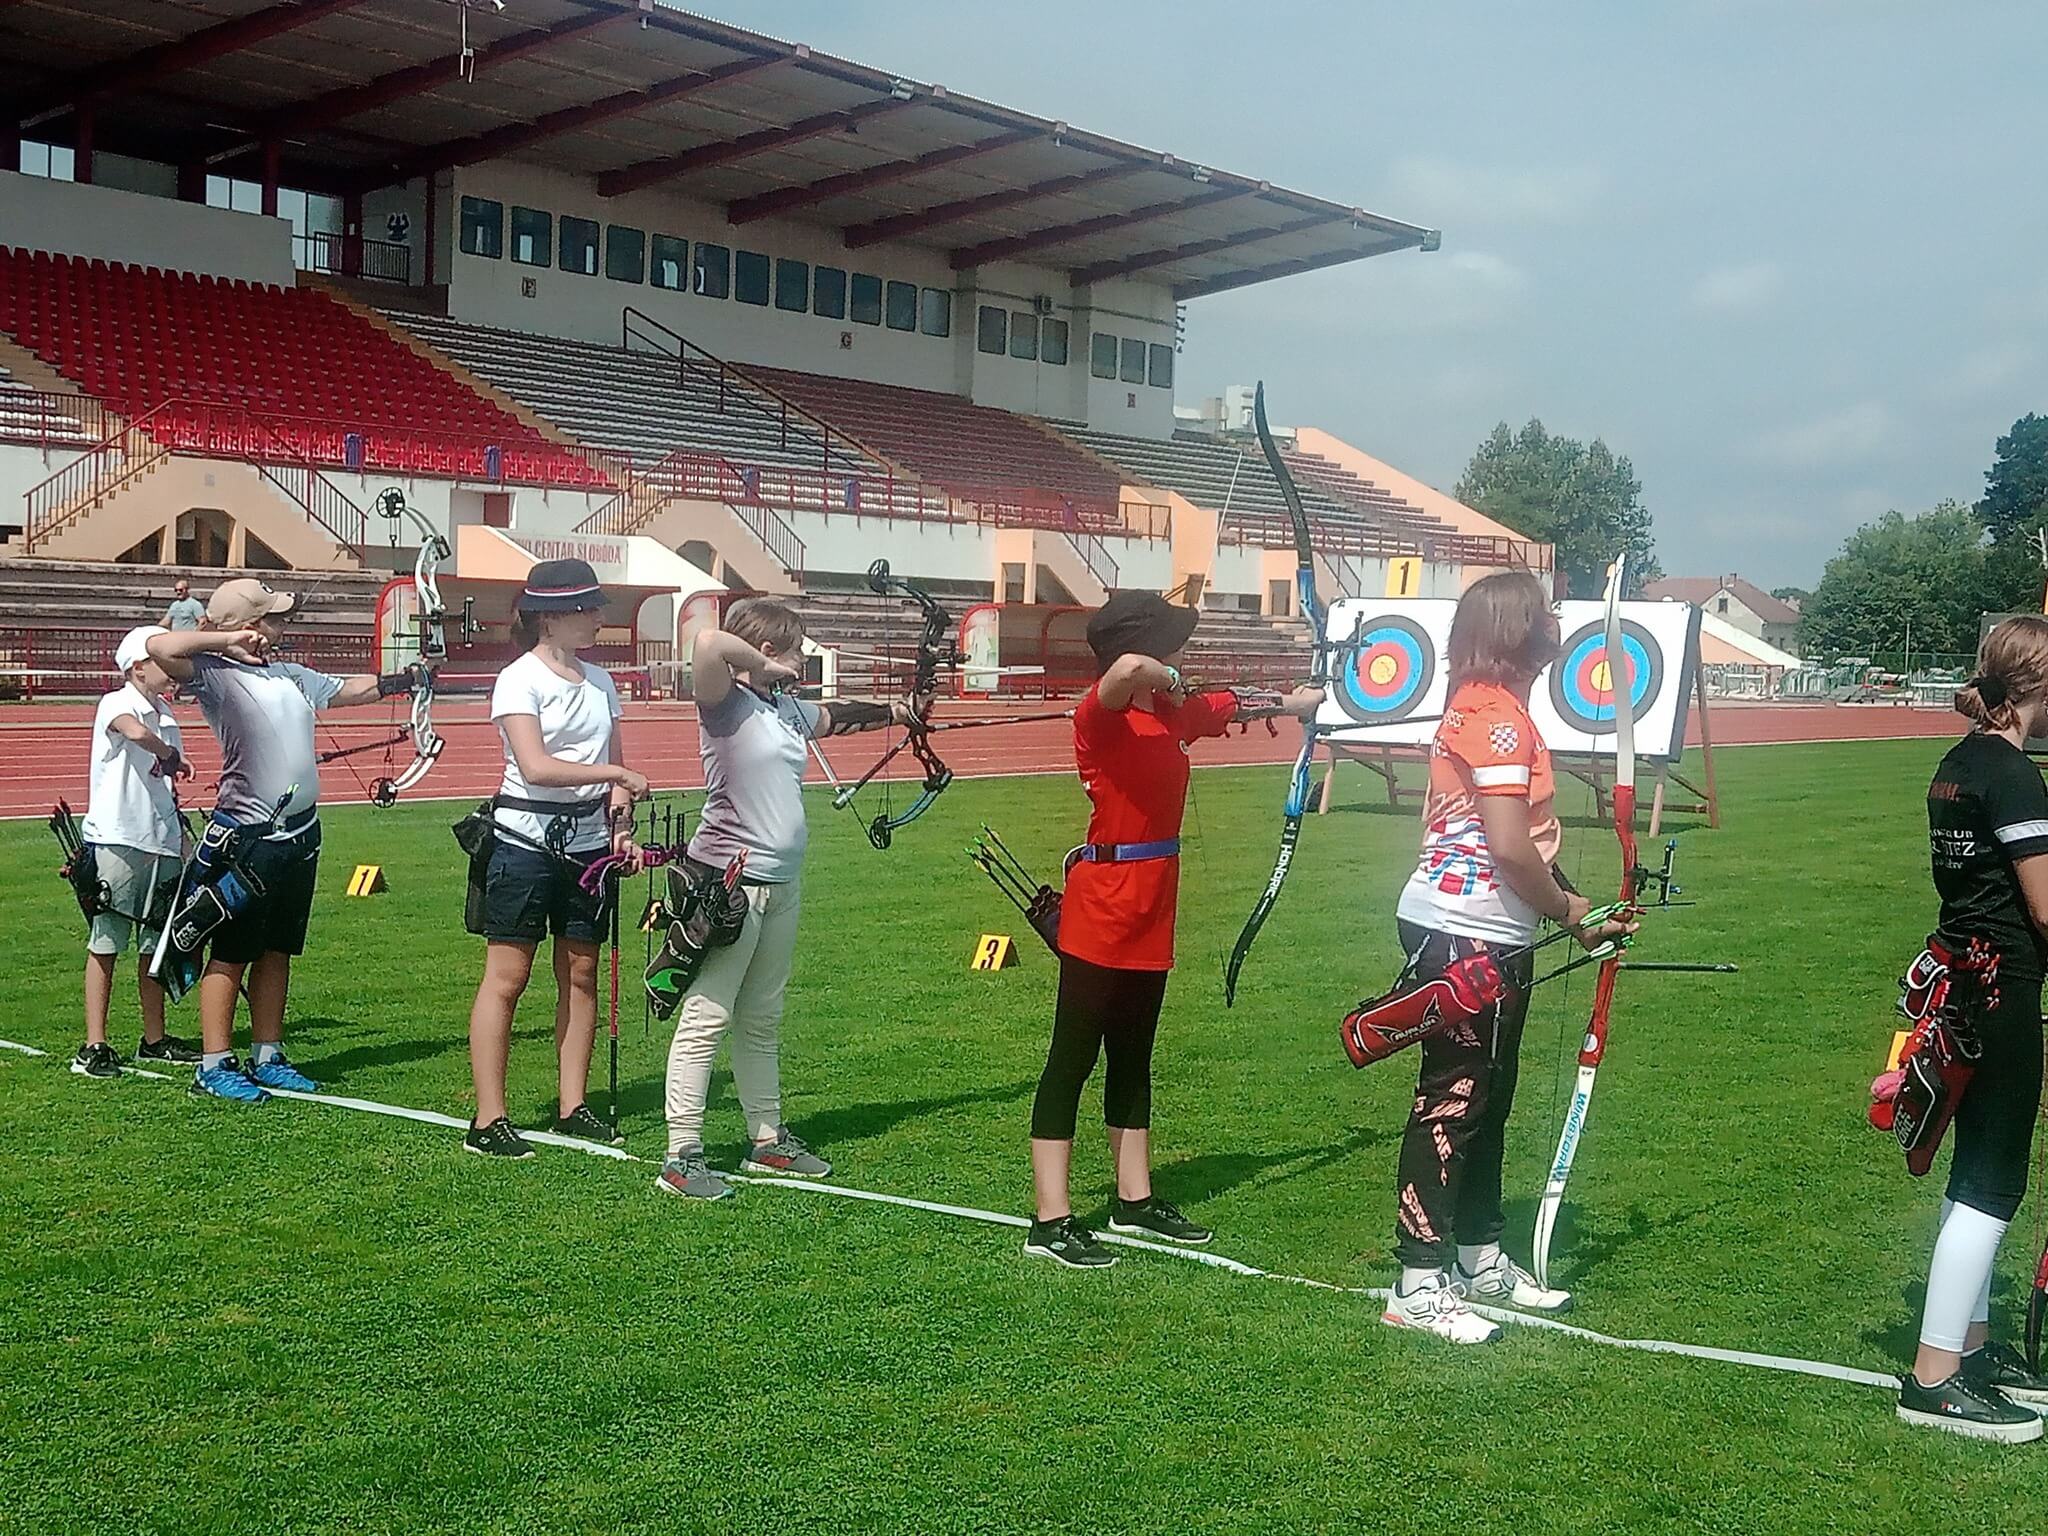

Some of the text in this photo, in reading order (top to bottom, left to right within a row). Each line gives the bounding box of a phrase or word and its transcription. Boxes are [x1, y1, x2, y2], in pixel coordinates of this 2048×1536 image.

[577, 542, 622, 564] SLOBODA
[1400, 561, 1410, 595] 1
[356, 869, 370, 896] 1
[1265, 844, 1292, 898] HONORIC
[980, 939, 1000, 970] 3
[1941, 1401, 1963, 1414] FILA
